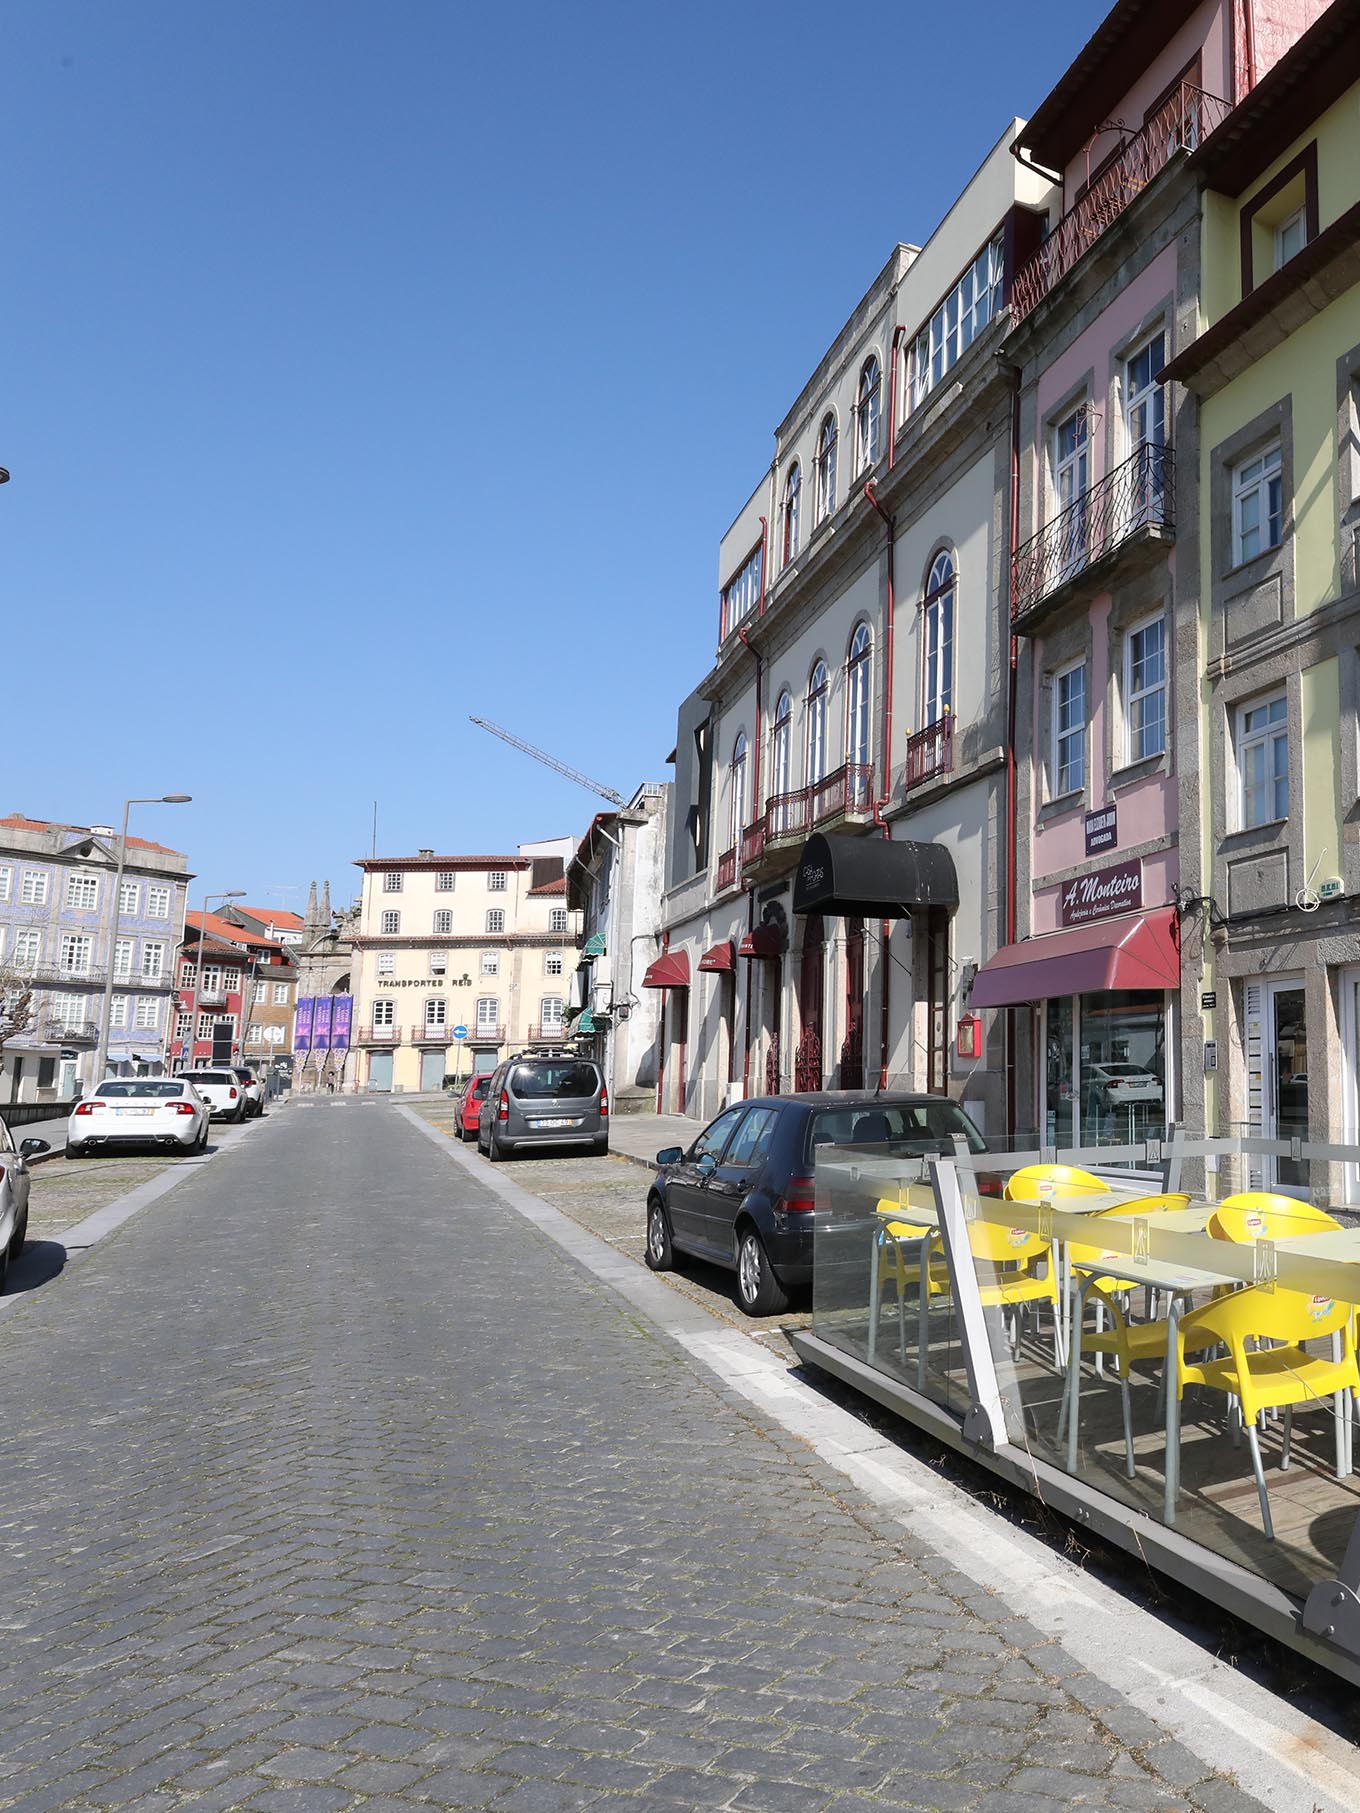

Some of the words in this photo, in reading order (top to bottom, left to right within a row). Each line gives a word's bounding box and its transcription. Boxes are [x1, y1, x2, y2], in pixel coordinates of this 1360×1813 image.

[1062, 881, 1079, 909] A.
[1080, 873, 1139, 903] Monteiro
[377, 980, 443, 988] TRANSPORTES
[452, 979, 472, 987] REIS
